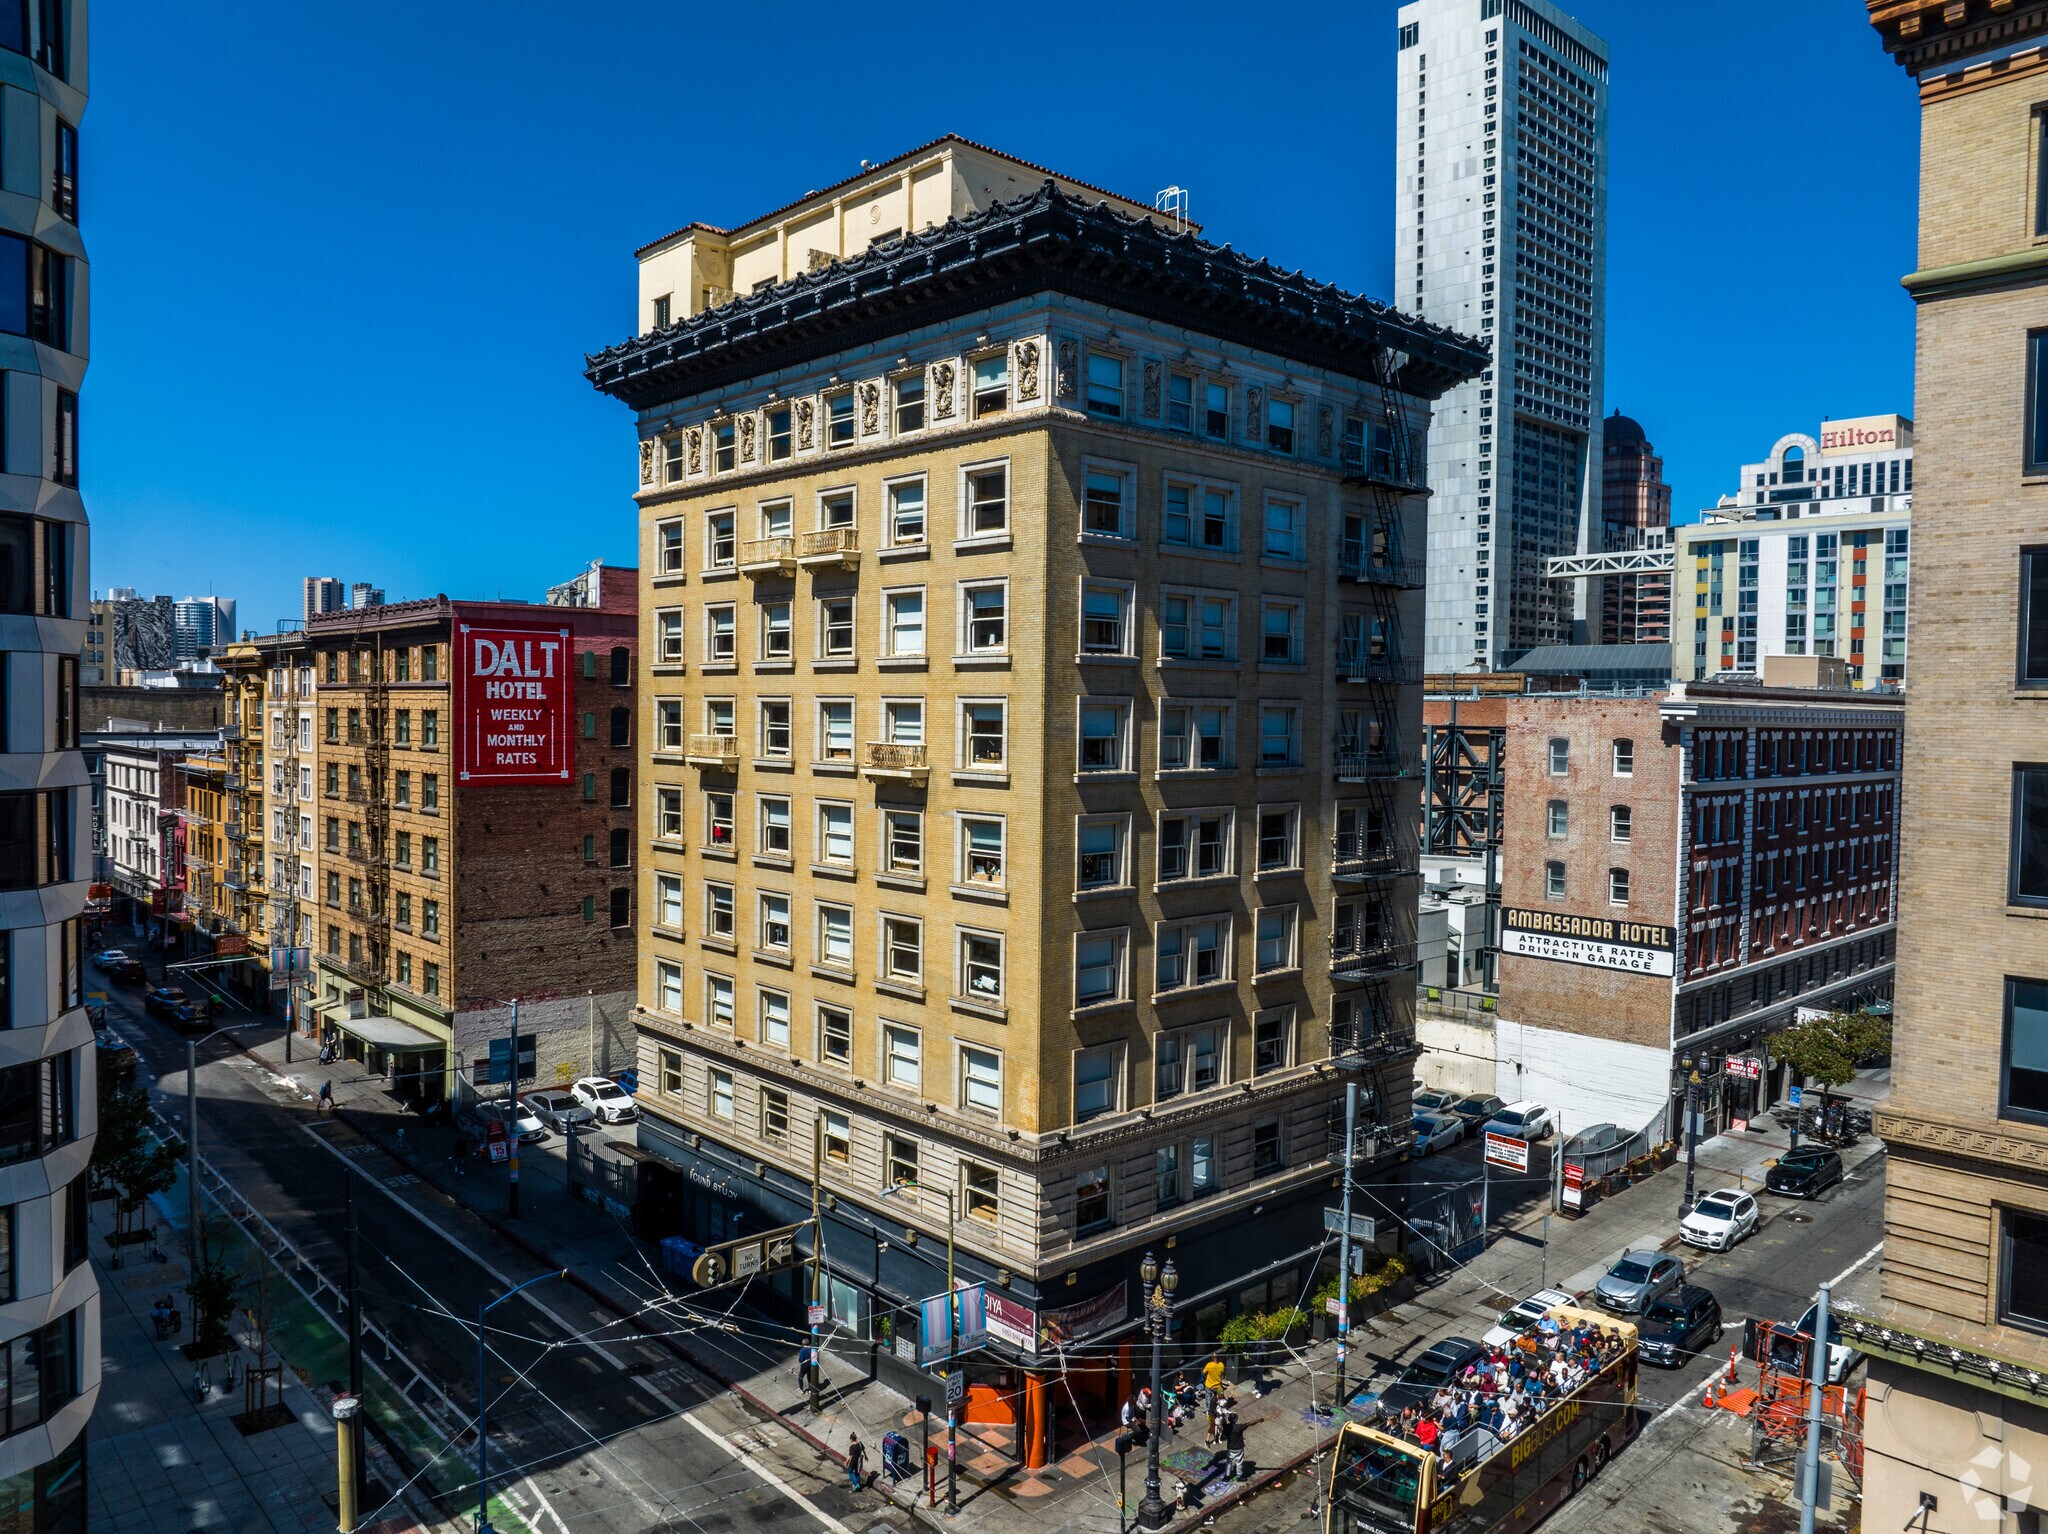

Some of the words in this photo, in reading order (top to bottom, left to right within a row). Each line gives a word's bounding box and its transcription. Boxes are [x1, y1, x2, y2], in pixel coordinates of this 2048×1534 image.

[1822, 427, 1894, 449] Hilton
[473, 639, 559, 678] DALT
[486, 681, 547, 700] HOTEL
[490, 709, 542, 721] WEEKLY
[487, 735, 546, 747] MONTHLY
[496, 752, 537, 764] RATES
[1508, 909, 1613, 939] AMBASSADOR
[1620, 922, 1669, 947] HOTEL
[1519, 935, 1603, 953] ATTRACTIVE
[1611, 947, 1655, 961] RATES
[1519, 943, 1580, 959] DRIVE-IN
[1588, 954, 1652, 970] GARAGE
[689, 1171, 711, 1188] FOUND
[712, 1182, 738, 1200] STUDY
[739, 1260, 759, 1270] TURNS
[744, 1253, 754, 1261] NO
[948, 1373, 962, 1381] SPEED
[947, 1385, 962, 1399] 20
